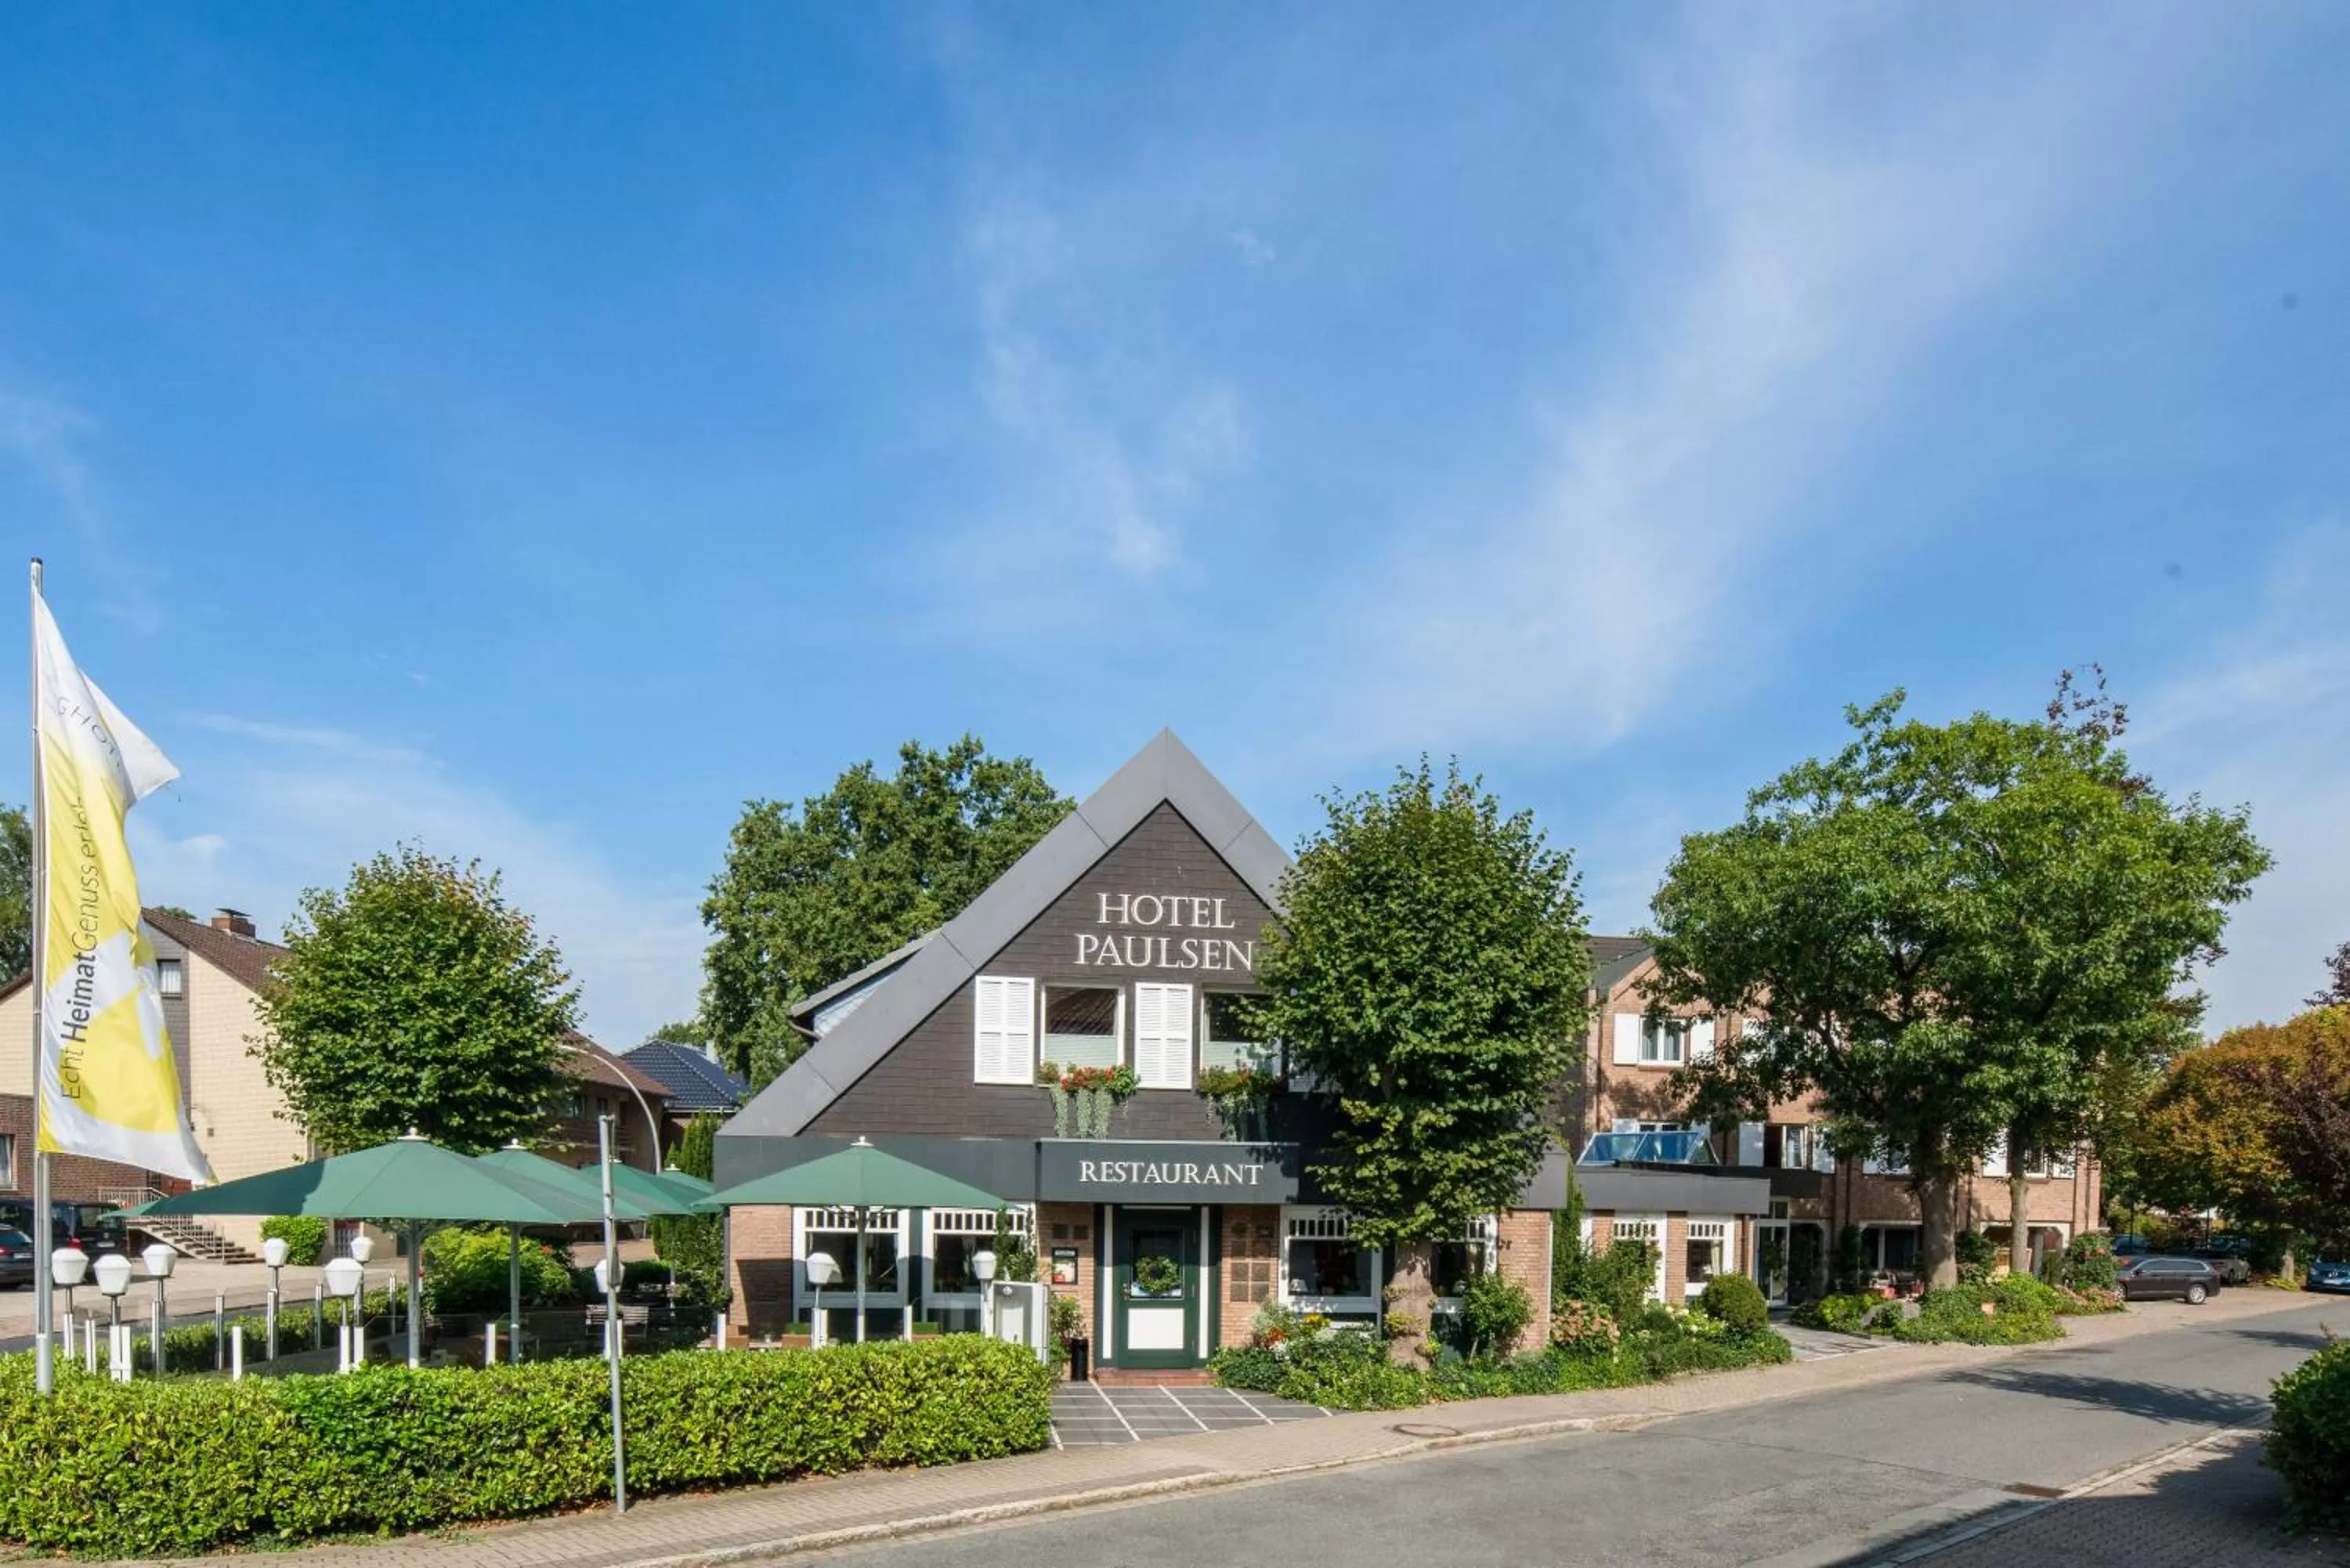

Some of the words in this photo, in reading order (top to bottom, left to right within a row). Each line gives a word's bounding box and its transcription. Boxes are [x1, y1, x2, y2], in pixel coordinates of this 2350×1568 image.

[1096, 892, 1235, 929] HOTEL
[1072, 933, 1253, 972] PAULSEN
[60, 1048, 85, 1100] Echt
[1079, 1161, 1264, 1186] RESTAURANT
